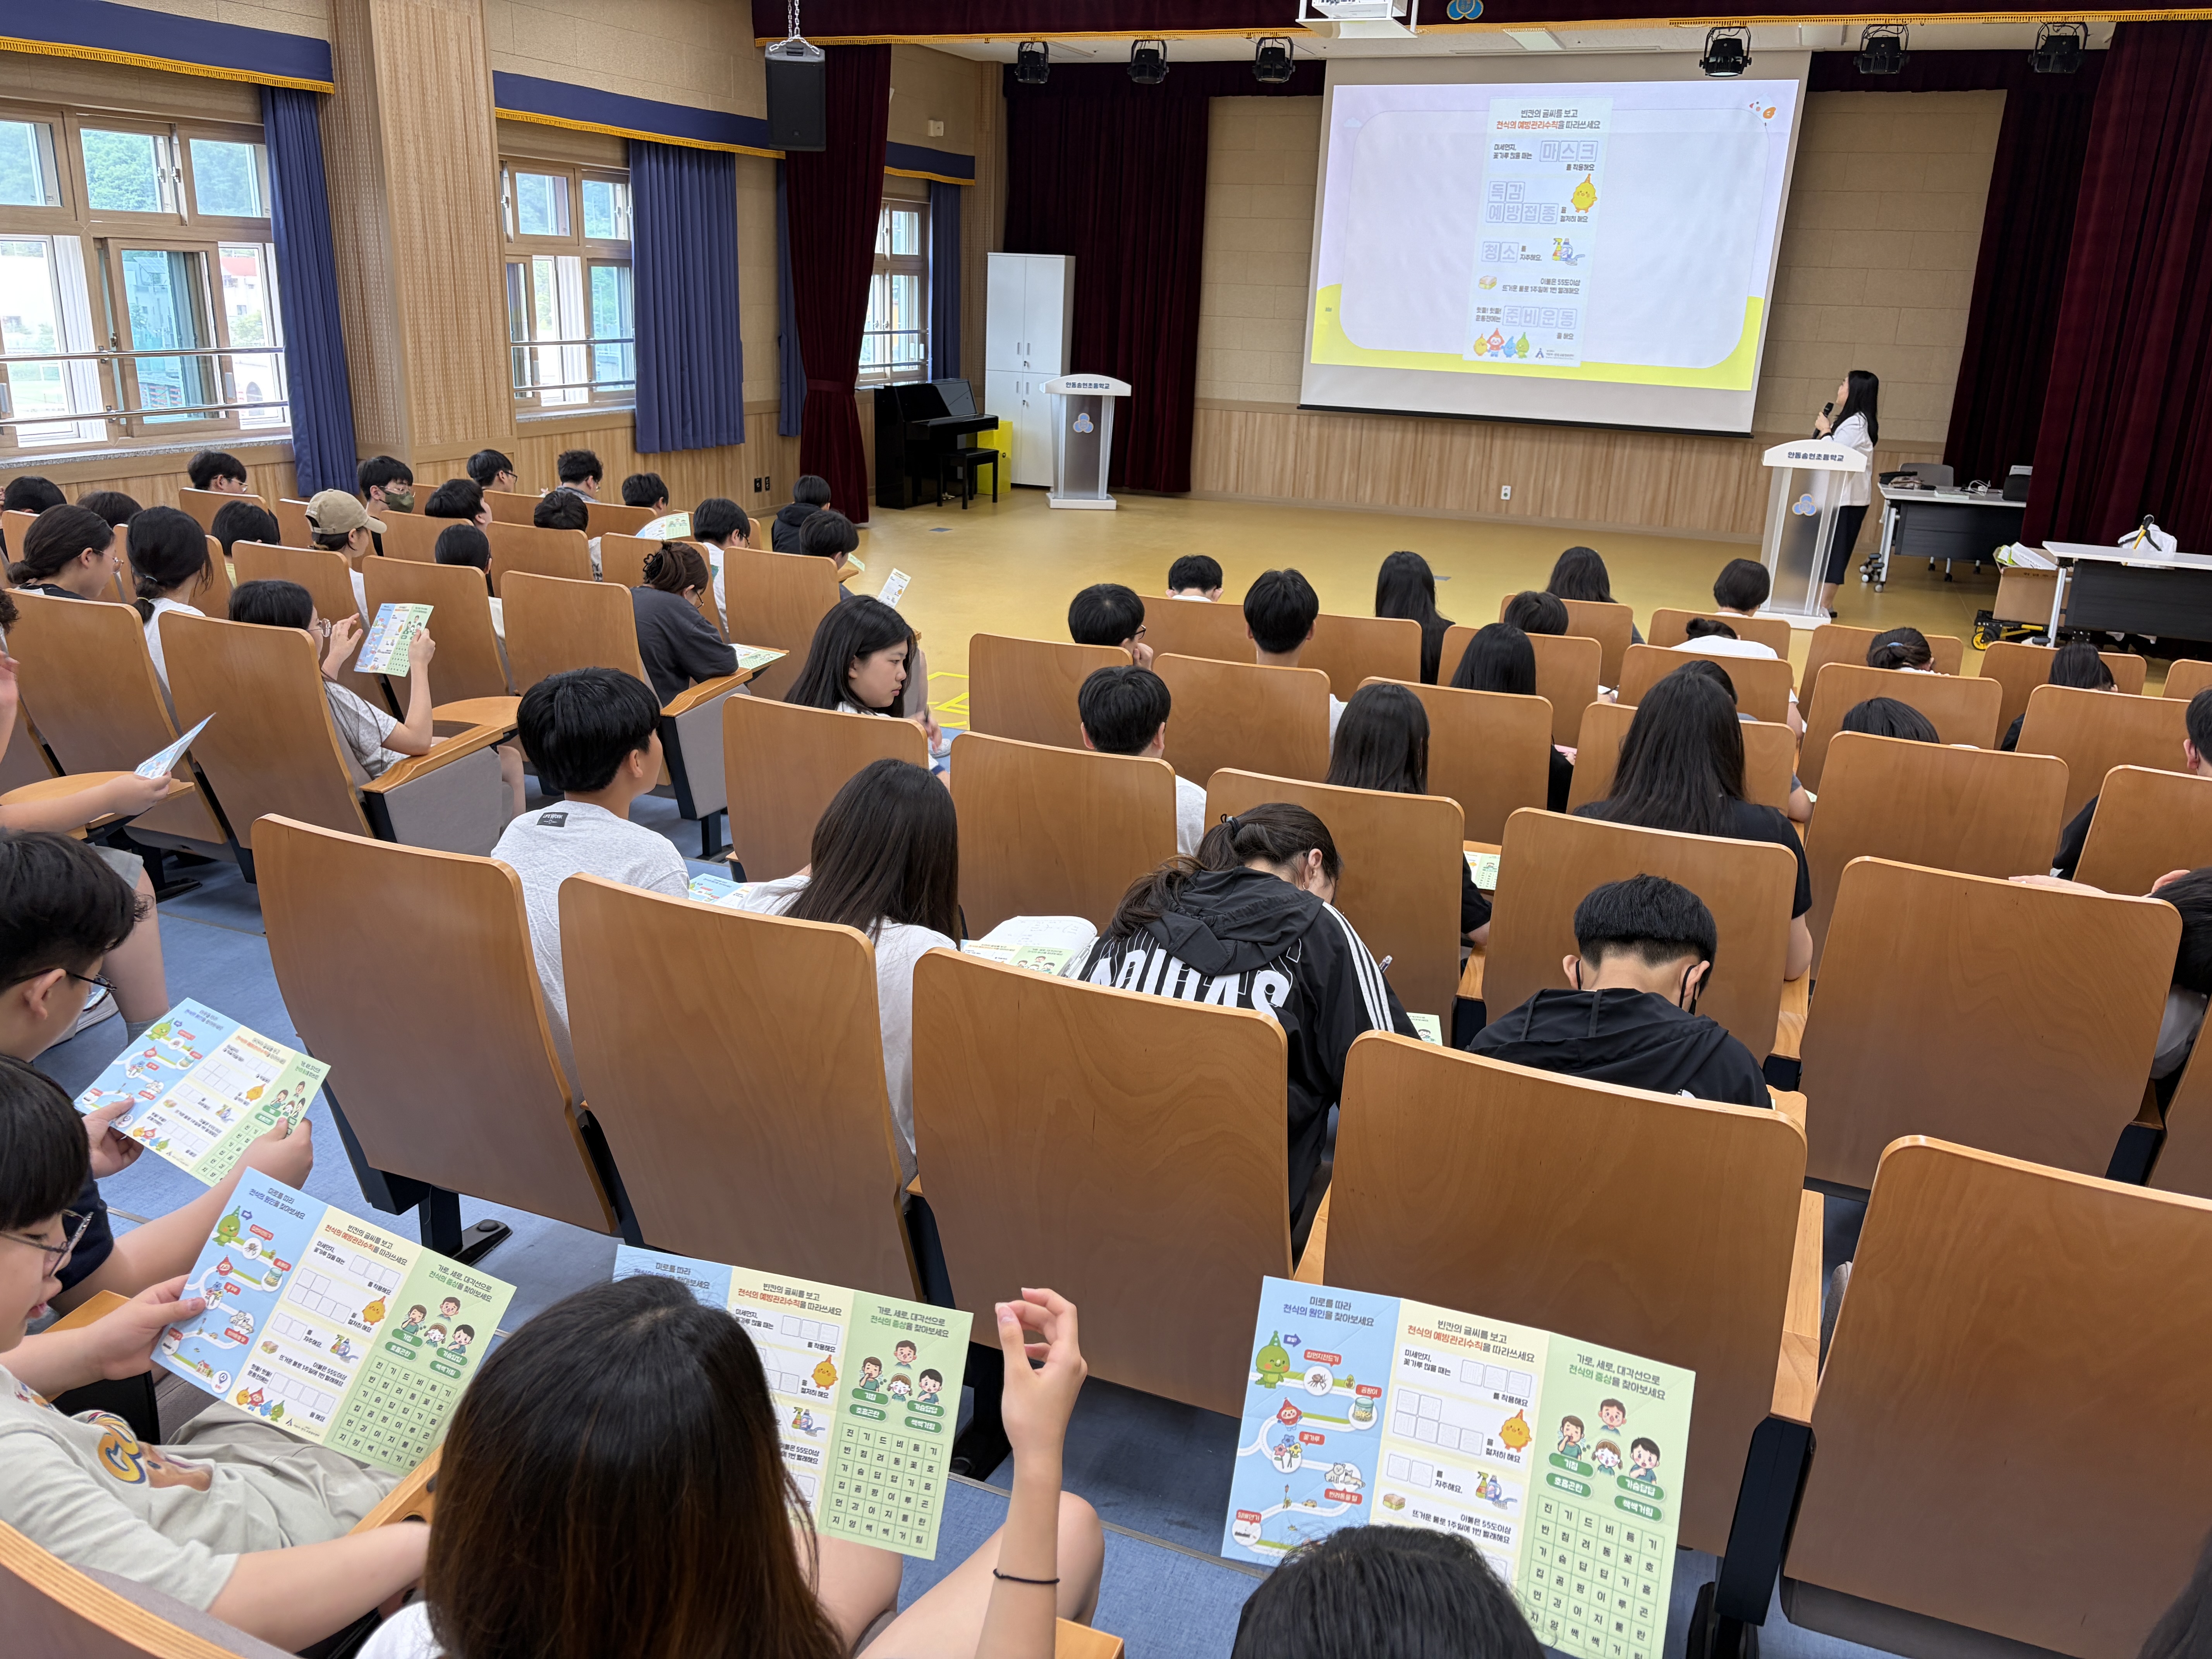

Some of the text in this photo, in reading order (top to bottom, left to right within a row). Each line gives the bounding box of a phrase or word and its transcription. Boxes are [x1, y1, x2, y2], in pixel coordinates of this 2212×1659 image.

[1521, 109, 1578, 118] 빈칸의 글씨를 보고
[1496, 120, 1600, 129] 천식의 예방관리수칙을 따라쓰세요
[1542, 143, 1594, 159] 마스크
[1491, 184, 1522, 200] 독감
[1489, 204, 1556, 222] 예방접종
[1485, 244, 1515, 260] 청소
[1506, 308, 1574, 327] 준비운동
[1788, 452, 1844, 462] 안동송현초등학교
[347, 1224, 365, 1238] 빈칸의
[380, 1239, 393, 1249] 보고
[325, 1224, 343, 1237] 천식의
[379, 1249, 408, 1266] 따라쓰세요
[428, 1271, 447, 1283] 천식의
[763, 1283, 820, 1301] 빈칸의 글씨를 보고
[738, 1288, 842, 1316] 천식의 예방관리수칙을 따라쓰세요
[1309, 1296, 1352, 1311] 미로를 따라
[911, 1313, 945, 1326] 대각선으로
[1283, 1304, 1374, 1326] 천식의 원인을 찾아보세요
[871, 1315, 949, 1338] 천식의 증상을 찾아보세요
[1437, 1320, 1507, 1344] 빈칸의 글씨를 보고
[1408, 1325, 1535, 1363] 천식의 예방관리수칙을 따라쓰세요
[1307, 1351, 1340, 1363] 집먼지진드기
[1405, 1349, 1432, 1362] 미세먼지,
[1403, 1358, 1451, 1376] 꽃가루 많을 때는
[1577, 1353, 1661, 1386] 가로, 세로, 대각선으로
[1569, 1364, 1666, 1400] 천식의 증상을 찾아보세요
[865, 1392, 876, 1401] 기침
[1361, 1386, 1378, 1395] 곰팡이
[1501, 1395, 1528, 1407] 착용해요
[856, 1407, 880, 1419] 호흡곤란
[1303, 1434, 1321, 1443] 꽃가루
[1486, 1448, 1521, 1463] 철저히 해요
[1565, 1459, 1578, 1471] 기침
[1554, 1477, 1583, 1494] 호흡곤란
[1625, 1479, 1656, 1496] 가슴답답
[1412, 1509, 1432, 1521] 뜨거운
[1623, 1499, 1653, 1517] 쌕쌕거림
[1460, 1514, 1511, 1535] 이불은 55도이상
